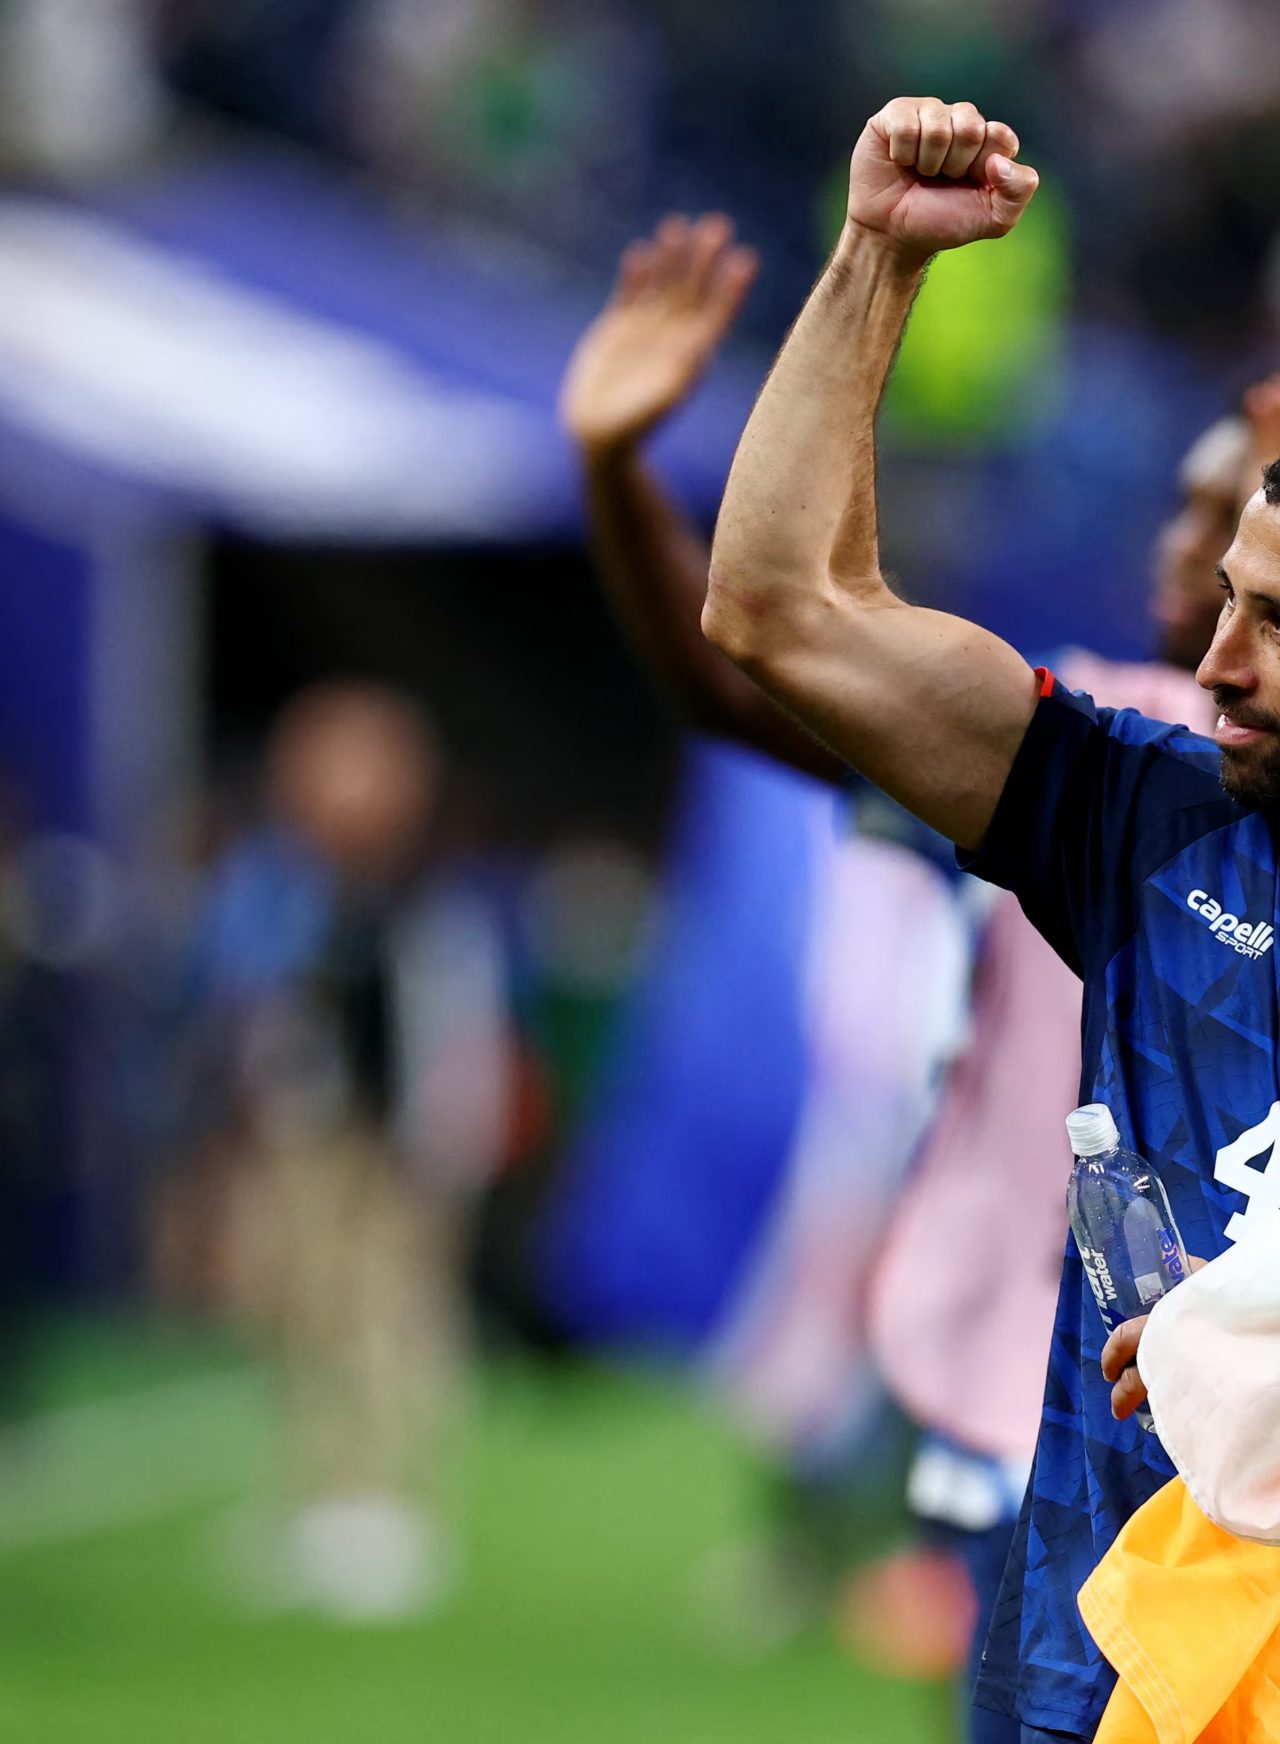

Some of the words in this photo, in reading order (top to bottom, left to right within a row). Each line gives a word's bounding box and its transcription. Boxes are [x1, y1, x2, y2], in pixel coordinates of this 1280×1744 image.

[1186, 889, 1274, 953] capelli
[1215, 930, 1263, 960] SPORT
[1091, 1248, 1118, 1300] water
